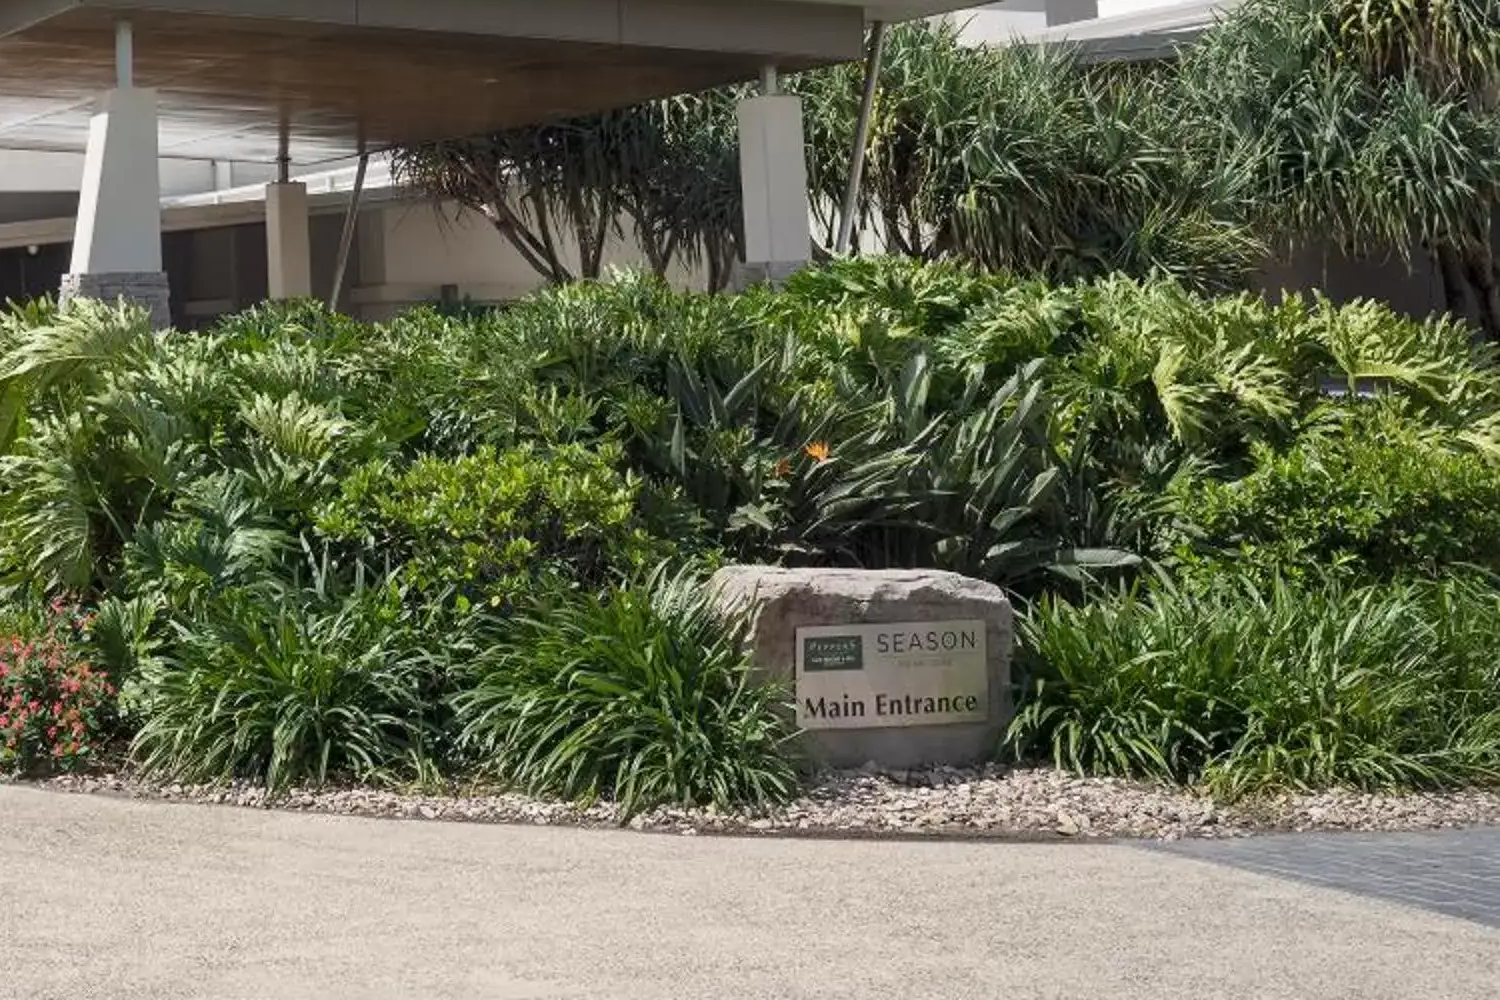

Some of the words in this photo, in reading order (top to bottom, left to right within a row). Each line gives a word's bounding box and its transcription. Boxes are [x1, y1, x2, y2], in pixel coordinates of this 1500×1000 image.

[877, 629, 976, 653] SEASON
[804, 694, 865, 718] Main
[875, 693, 977, 715] Entrance
